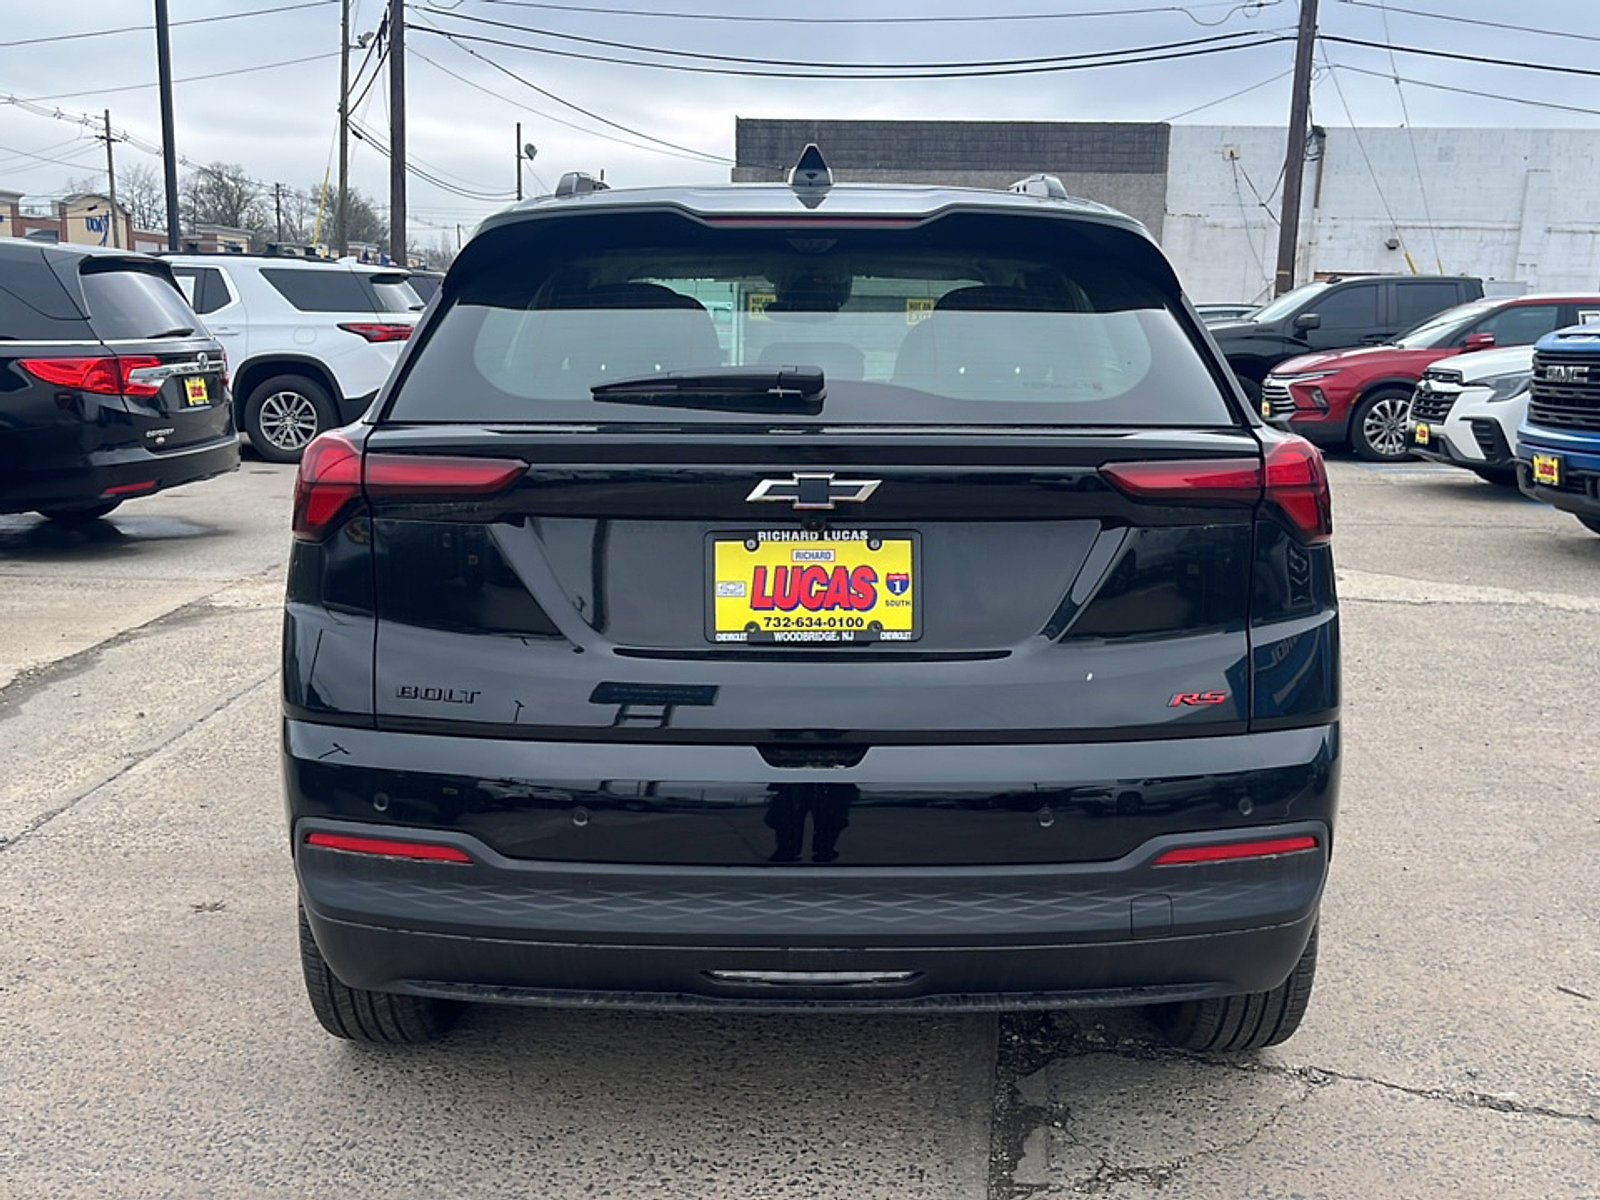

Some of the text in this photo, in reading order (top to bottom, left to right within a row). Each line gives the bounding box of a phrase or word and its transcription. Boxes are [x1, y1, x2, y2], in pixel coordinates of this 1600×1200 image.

[1546, 364, 1589, 383] GMC
[757, 530, 869, 541] RICHARD LUCAS
[795, 551, 832, 560] RICHARD
[750, 564, 879, 612] LUCAS
[842, 631, 854, 641] NJ
[396, 685, 481, 704] BOLT
[1166, 690, 1227, 707] RS
